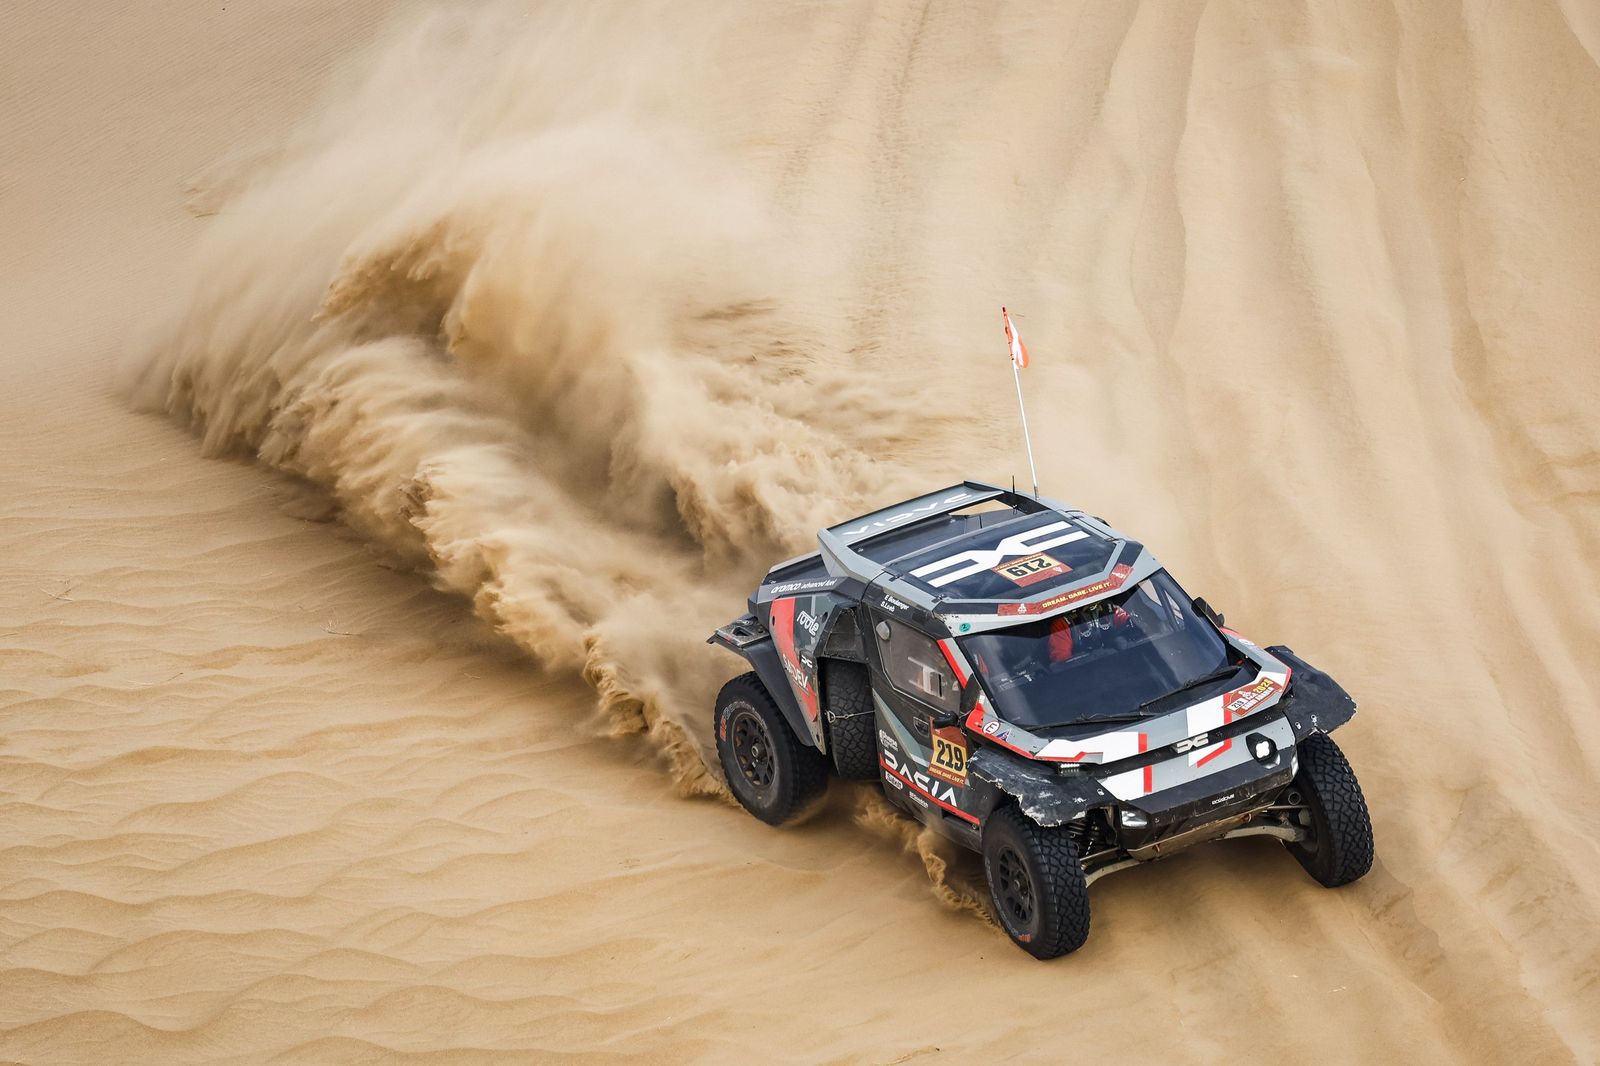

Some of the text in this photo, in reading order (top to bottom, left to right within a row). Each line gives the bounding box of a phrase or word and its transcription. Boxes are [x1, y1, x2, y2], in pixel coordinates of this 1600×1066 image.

[1006, 558, 1052, 577] 219
[771, 582, 801, 594] aramco
[1089, 584, 1103, 592] LIVE
[936, 739, 964, 772] 219
[884, 749, 957, 807] DACIA
